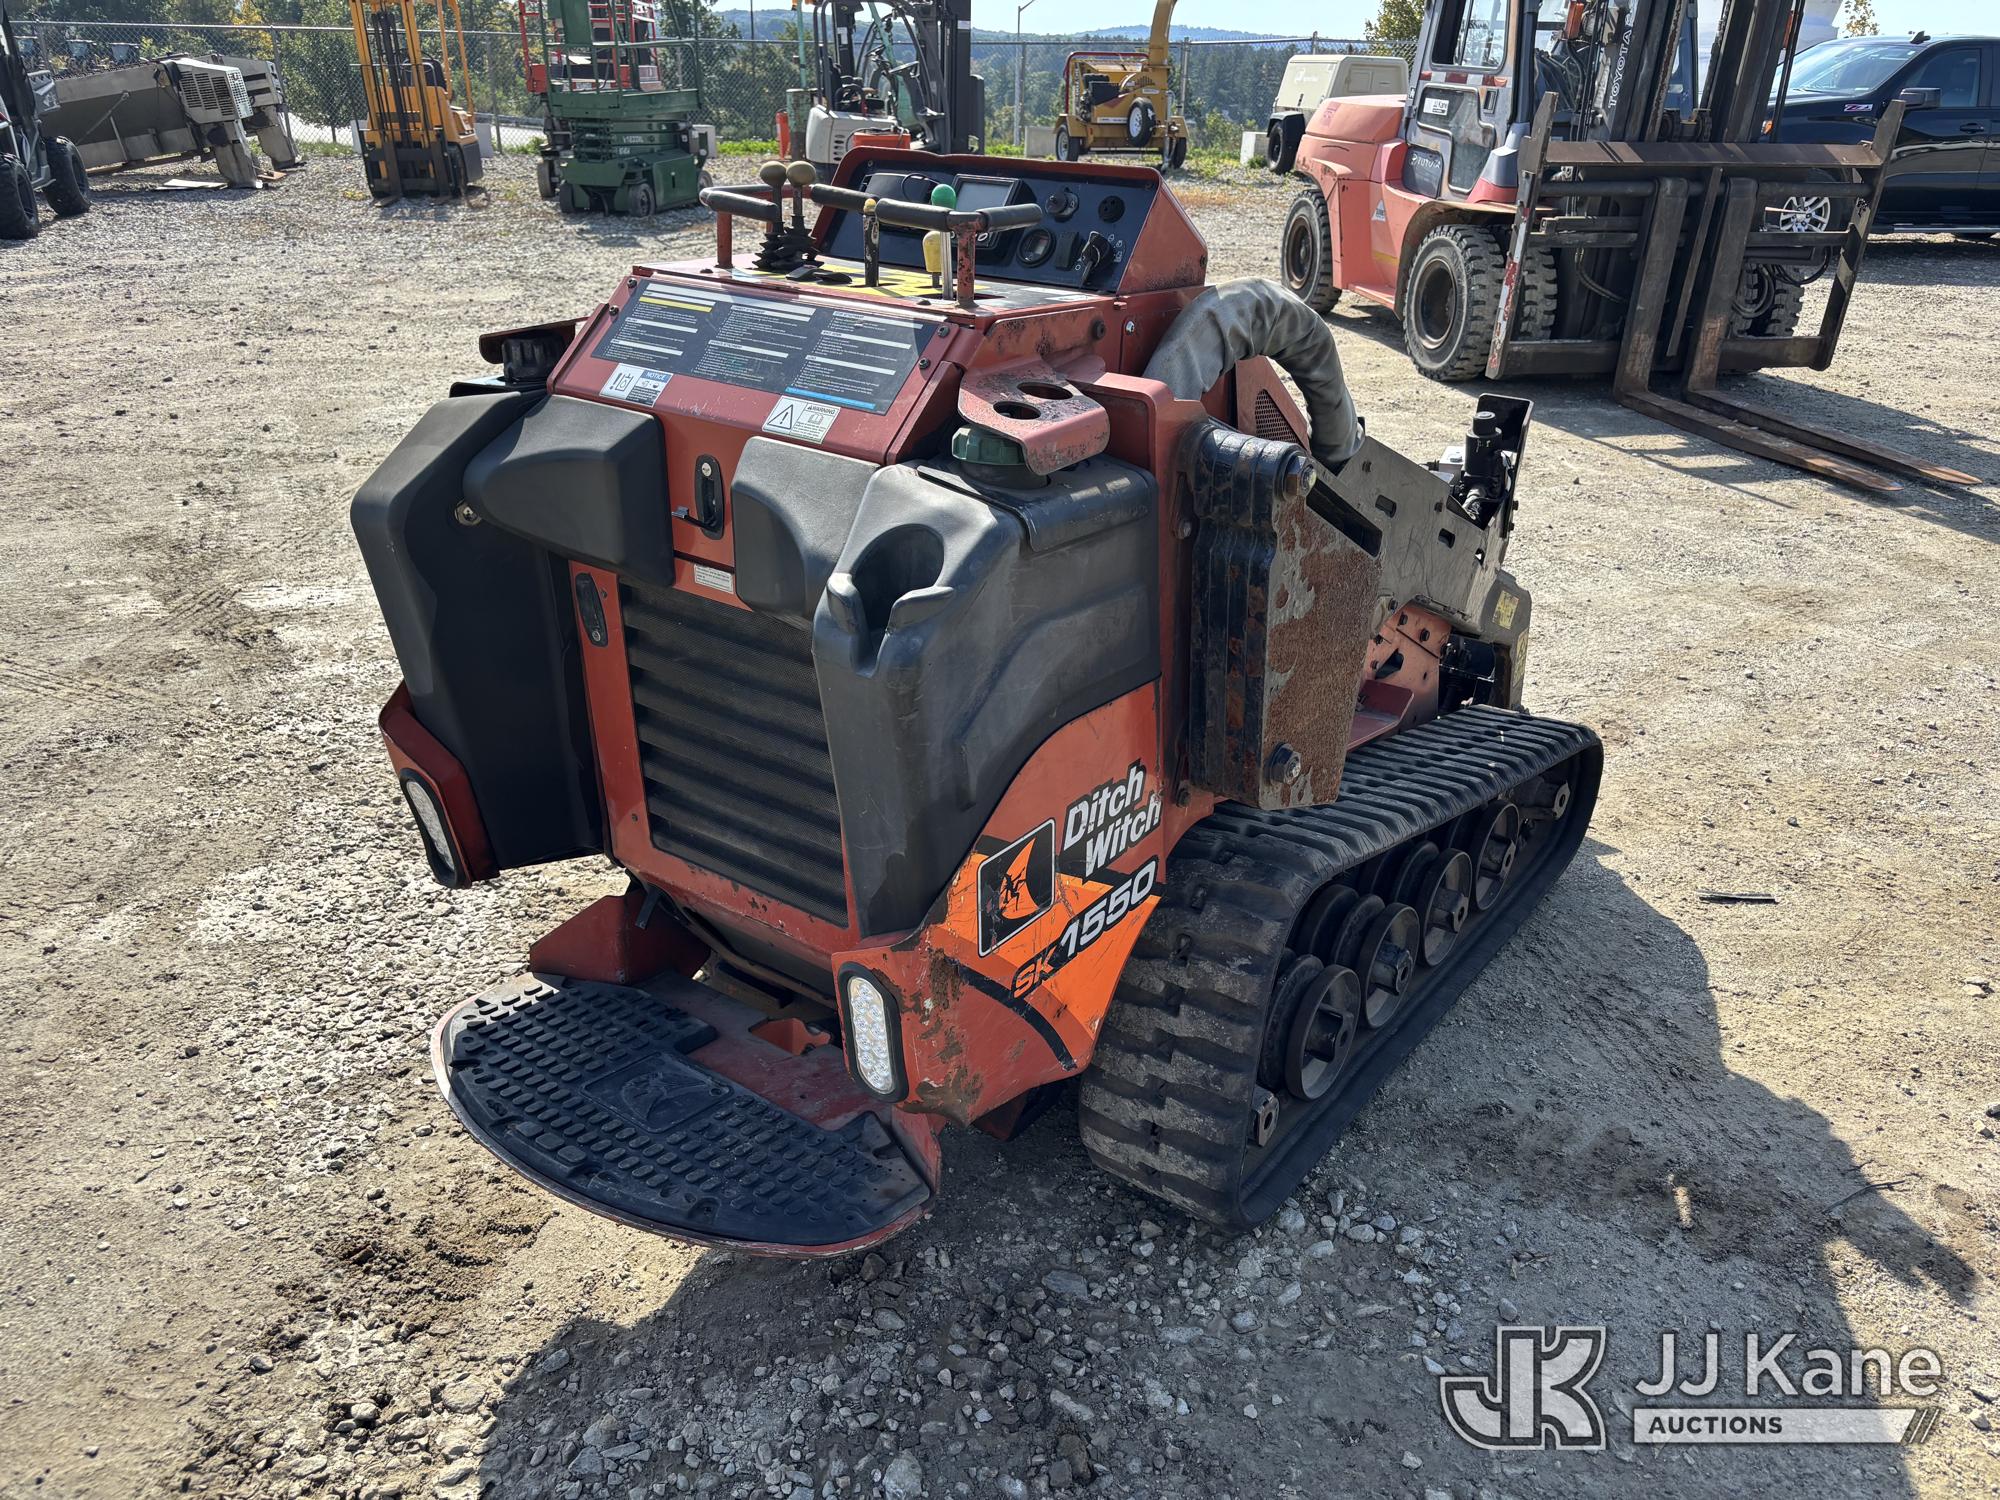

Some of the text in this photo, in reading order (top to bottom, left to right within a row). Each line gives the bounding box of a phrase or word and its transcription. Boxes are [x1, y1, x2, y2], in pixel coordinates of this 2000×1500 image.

[1608, 29, 1632, 109] TOYOTA
[646, 371, 669, 381] NOTICE
[811, 404, 836, 415] WARNING
[1064, 766, 1145, 851] Ditch
[1086, 793, 1161, 877] Witch
